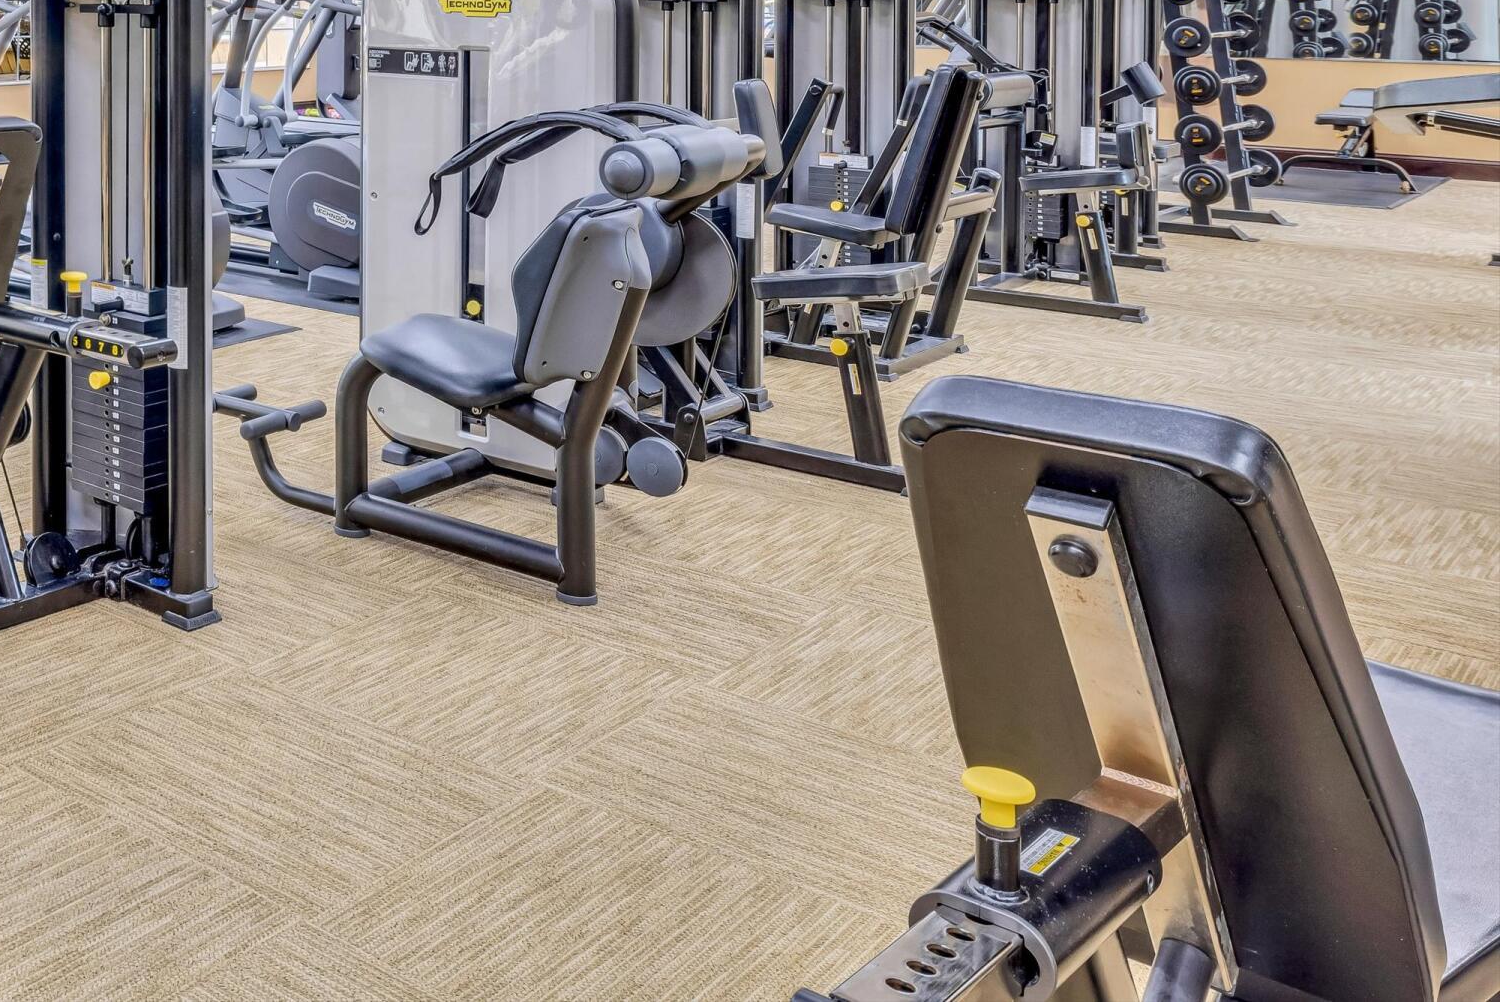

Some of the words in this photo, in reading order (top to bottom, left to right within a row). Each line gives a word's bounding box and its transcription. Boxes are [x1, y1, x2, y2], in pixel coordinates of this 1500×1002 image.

[85, 338, 92, 350] 6
[98, 341, 105, 352] 7
[111, 345, 119, 356] 8
